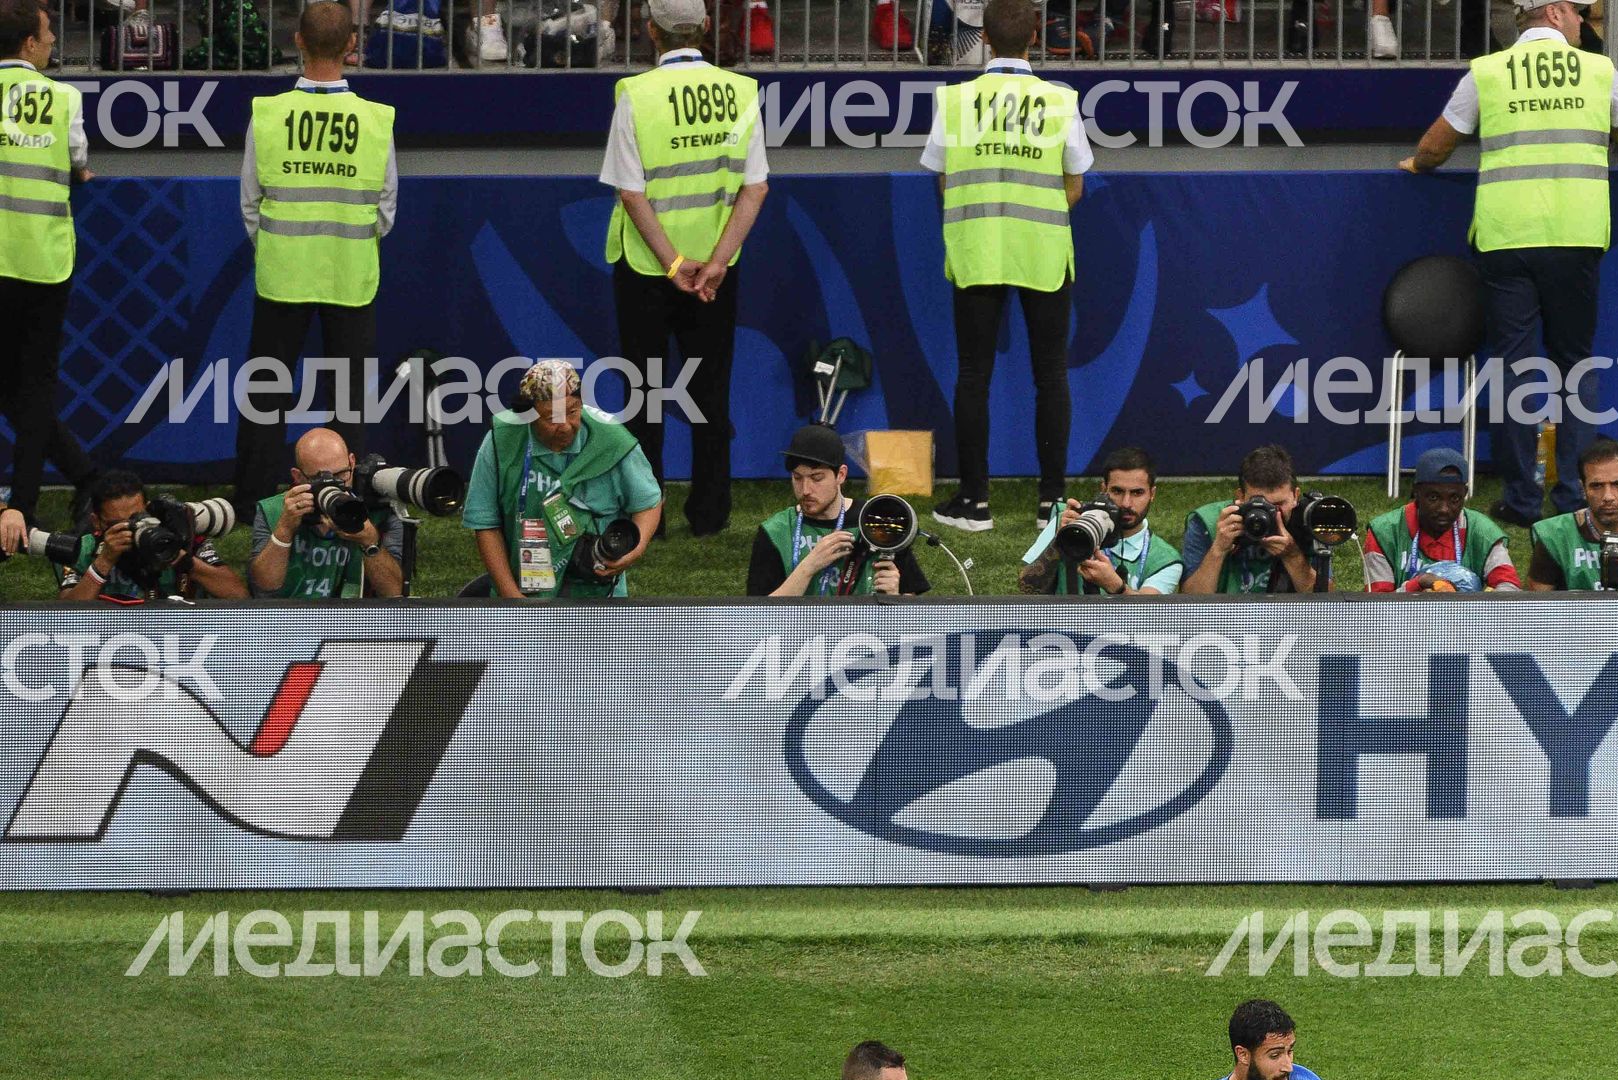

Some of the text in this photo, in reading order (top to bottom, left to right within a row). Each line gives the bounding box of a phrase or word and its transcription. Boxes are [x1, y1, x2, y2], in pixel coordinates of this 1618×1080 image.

[1506, 50, 1581, 90] 11659
[668, 83, 738, 126] 10898
[974, 91, 1047, 137] 11243
[1508, 96, 1585, 114] STEWARD
[285, 109, 359, 154] 10759
[670, 131, 739, 149] STEWARD
[975, 142, 1043, 160] STEWARD
[282, 160, 357, 178] STEWARD
